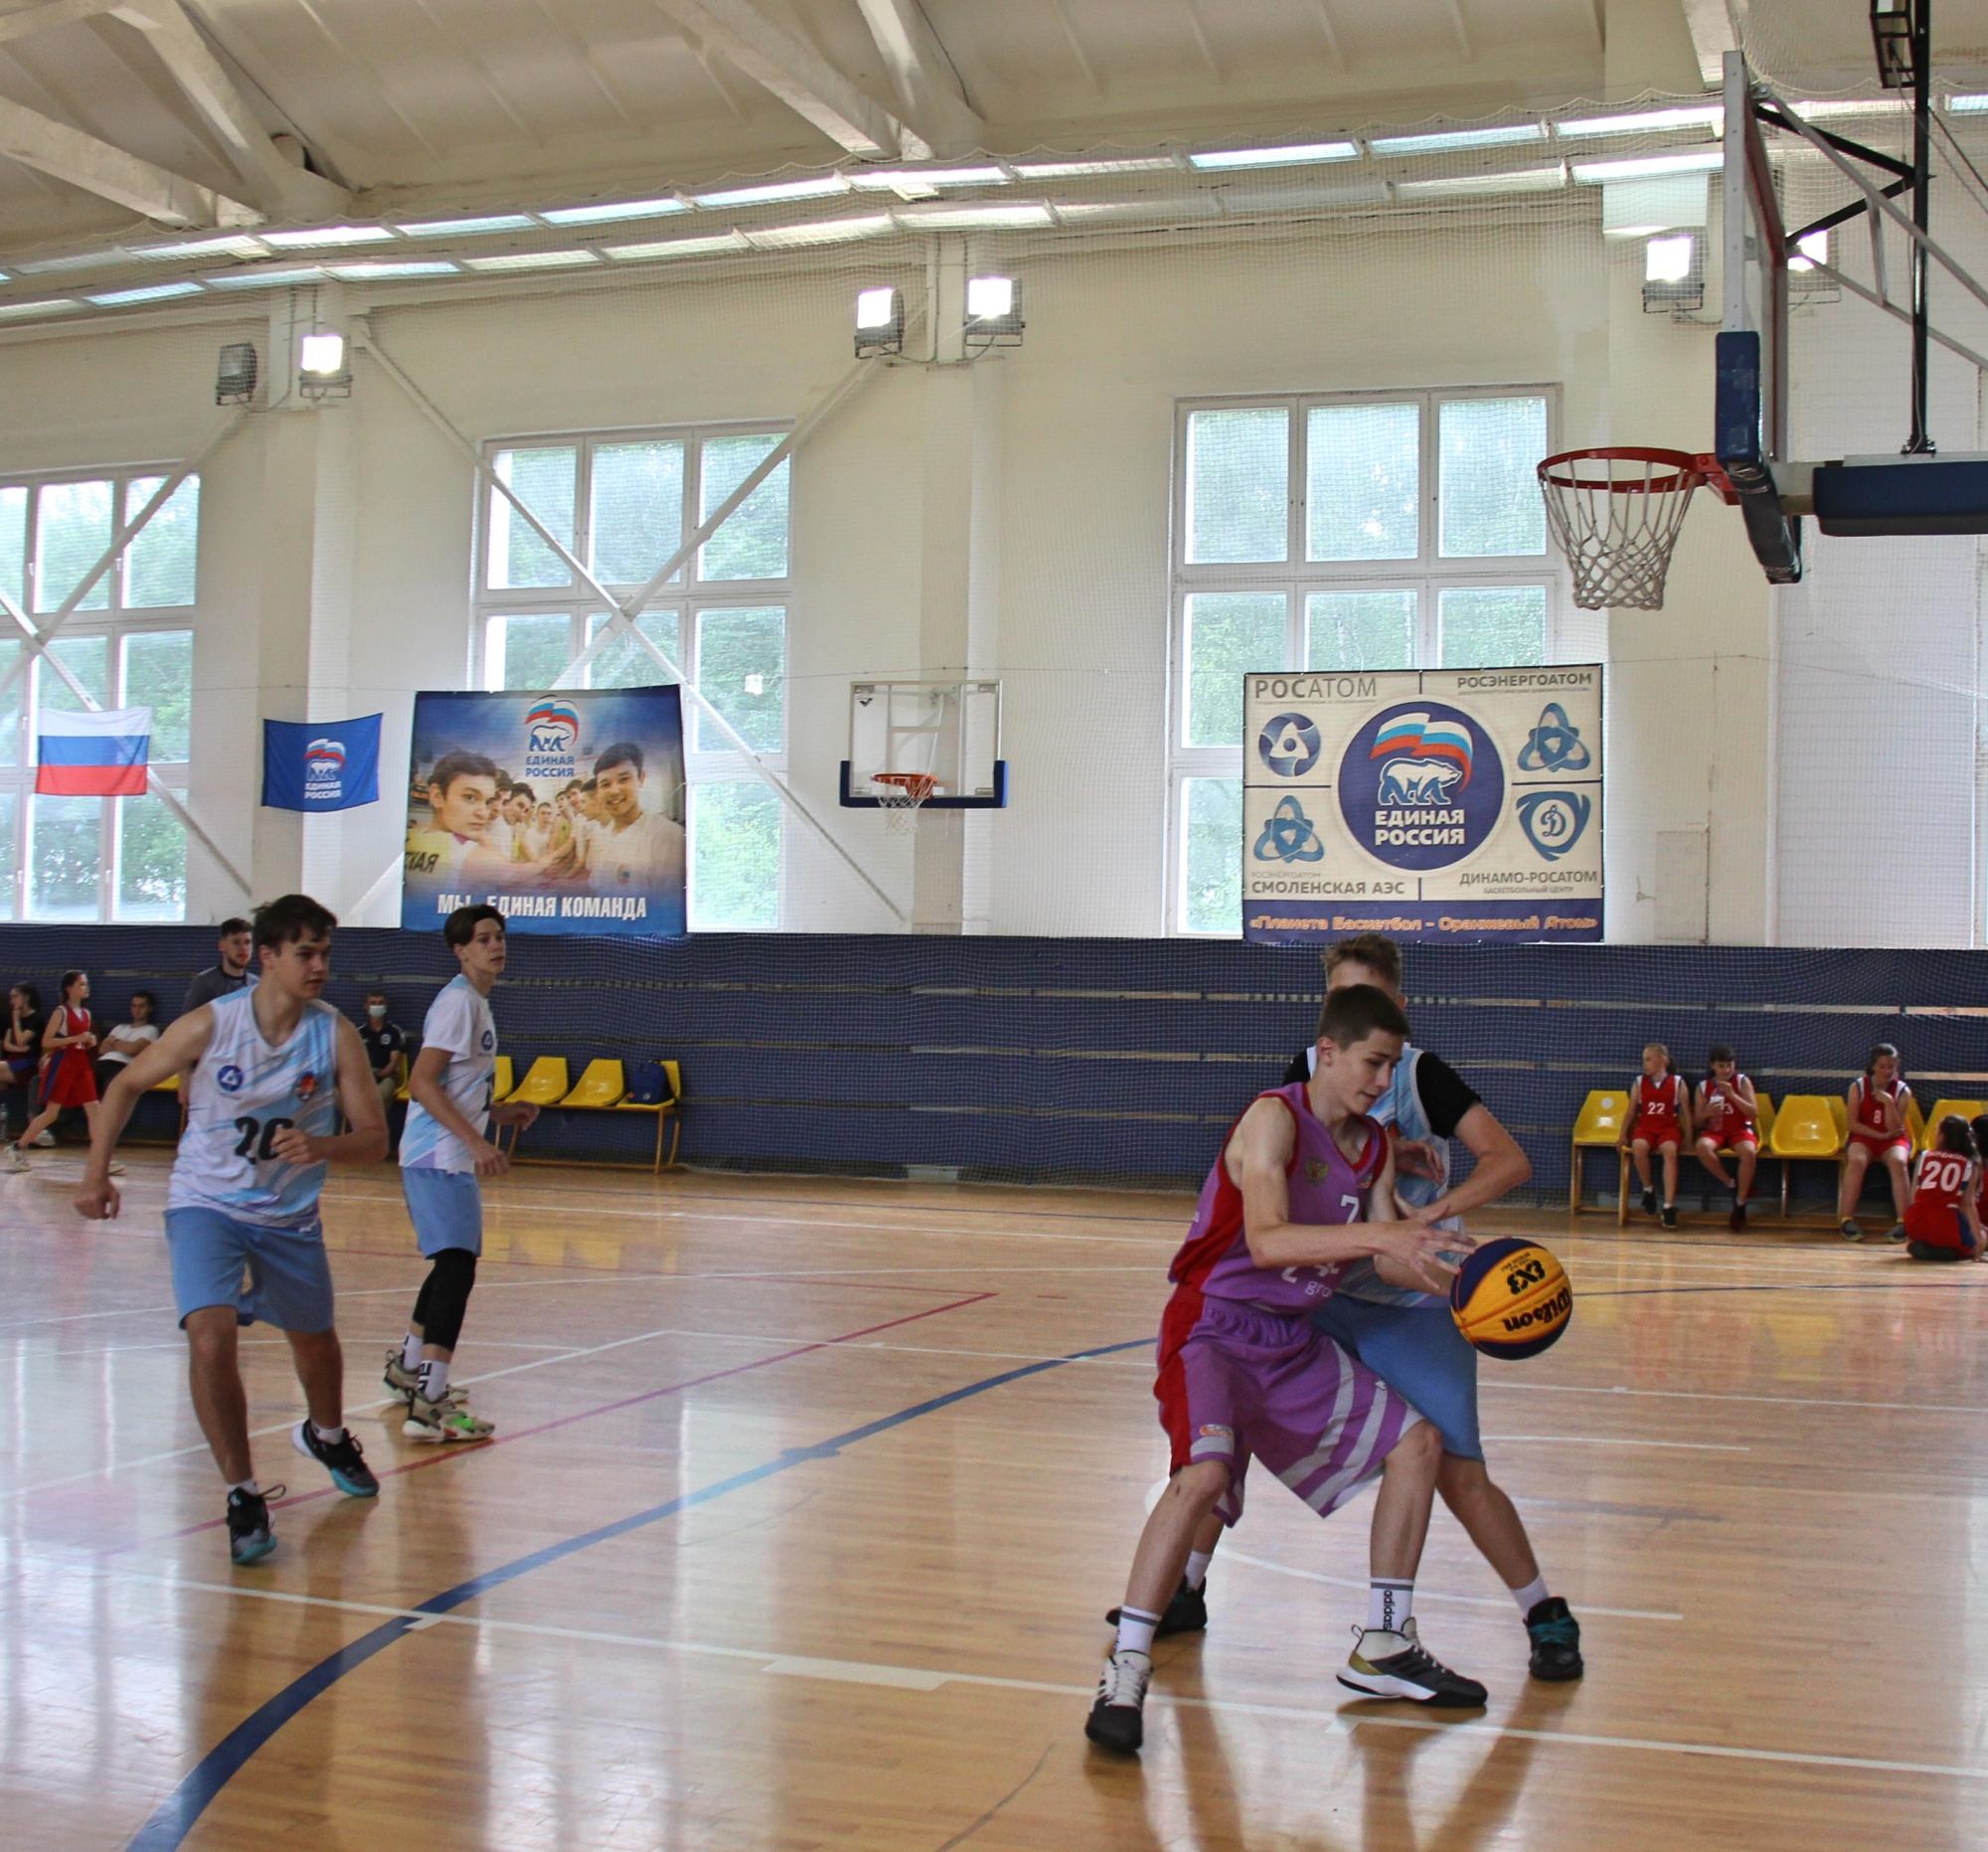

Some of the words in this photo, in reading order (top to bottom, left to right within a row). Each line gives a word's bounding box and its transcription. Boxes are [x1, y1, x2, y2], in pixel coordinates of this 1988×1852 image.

[1255, 678, 1377, 699] РОСАТОМ
[1457, 673, 1592, 688] РОСЭНЕРГОАТОМ
[526, 756, 575, 765] ЕДИНАЯ
[526, 767, 574, 777] РОССИЯ
[1375, 809, 1465, 827] ЕДИНАЯ
[1375, 828, 1465, 846] РОССИЯ
[1459, 871, 1598, 887] ДИНАМО-РОСАТОМ
[1251, 881, 1367, 895] СМОЛЕНСКАЯ
[1372, 882, 1406, 895] АЭС
[486, 895, 555, 920] ЕДИНАЯ
[561, 897, 646, 921] КОМАНДА
[1647, 1101, 1666, 1115] 22
[1873, 1109, 1882, 1124] 8
[1920, 1160, 1962, 1193] 20
[1340, 1194, 1360, 1225] 7
